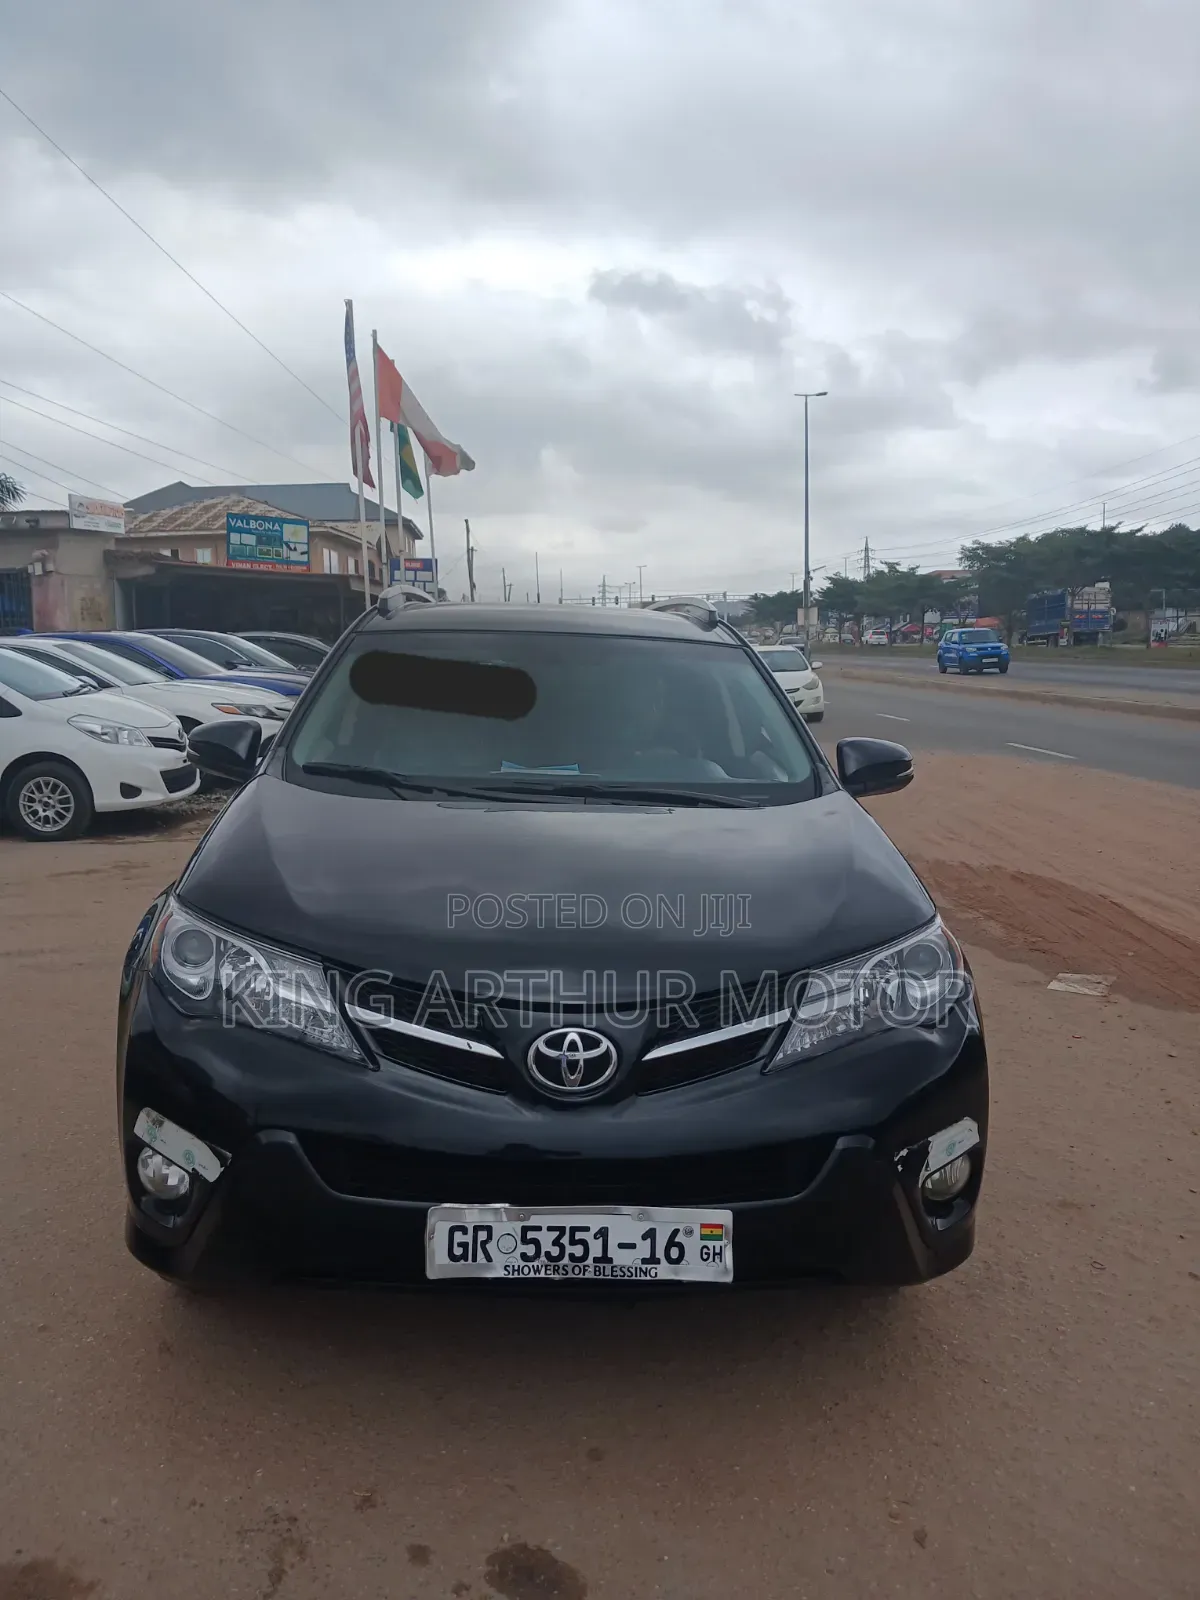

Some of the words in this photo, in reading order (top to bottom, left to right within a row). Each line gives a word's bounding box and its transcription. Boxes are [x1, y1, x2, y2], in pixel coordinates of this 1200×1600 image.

[229, 517, 281, 530] VALBONA
[447, 1224, 494, 1263] GR
[519, 1225, 686, 1265] 5351-16
[699, 1244, 723, 1263] GH
[503, 1264, 570, 1277] SHOWERS
[572, 1265, 588, 1277] OF
[593, 1265, 659, 1279] BLESSING
